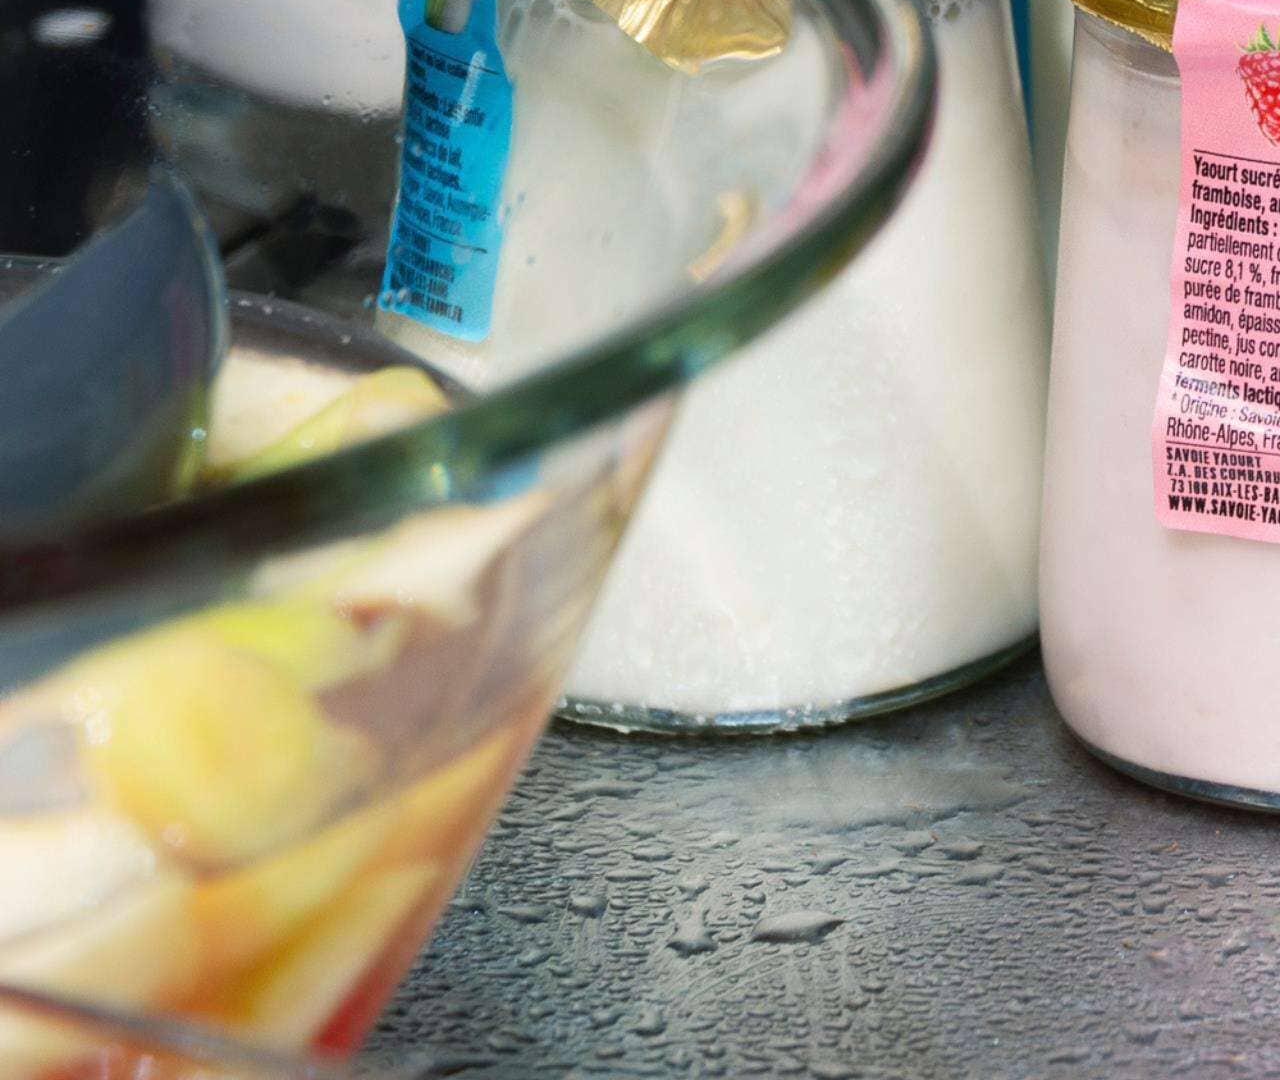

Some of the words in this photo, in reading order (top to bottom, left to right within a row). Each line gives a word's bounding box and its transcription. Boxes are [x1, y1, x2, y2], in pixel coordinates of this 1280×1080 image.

[1193, 155, 1238, 183] Yaourt
[1240, 166, 1280, 189] sucré
[1192, 180, 1265, 214] framboise,
[1190, 203, 1269, 237] Ingrédients
[1187, 230, 1274, 262] partiellement
[1185, 256, 1221, 276] sucre
[1225, 261, 1243, 282] 8,1
[1249, 264, 1267, 286] %,
[1184, 279, 1221, 300] purée
[1225, 284, 1241, 304] de
[1183, 303, 1234, 331] amidon,
[1181, 327, 1232, 355] pectine,
[1235, 336, 1256, 357] jus
[1179, 351, 1226, 373] carotte
[1229, 360, 1266, 383] noire,
[1175, 370, 1240, 400] ferments
[1180, 393, 1228, 421] Origine
[1166, 416, 1258, 450] Rhône-Alpes,
[1166, 447, 1209, 464] SAVOIE
[1213, 453, 1261, 468] YAOURT
[1167, 463, 1191, 478] Z.A.
[1194, 466, 1217, 480] DES
[1170, 479, 1185, 493] 73
[1188, 480, 1209, 495] 100
